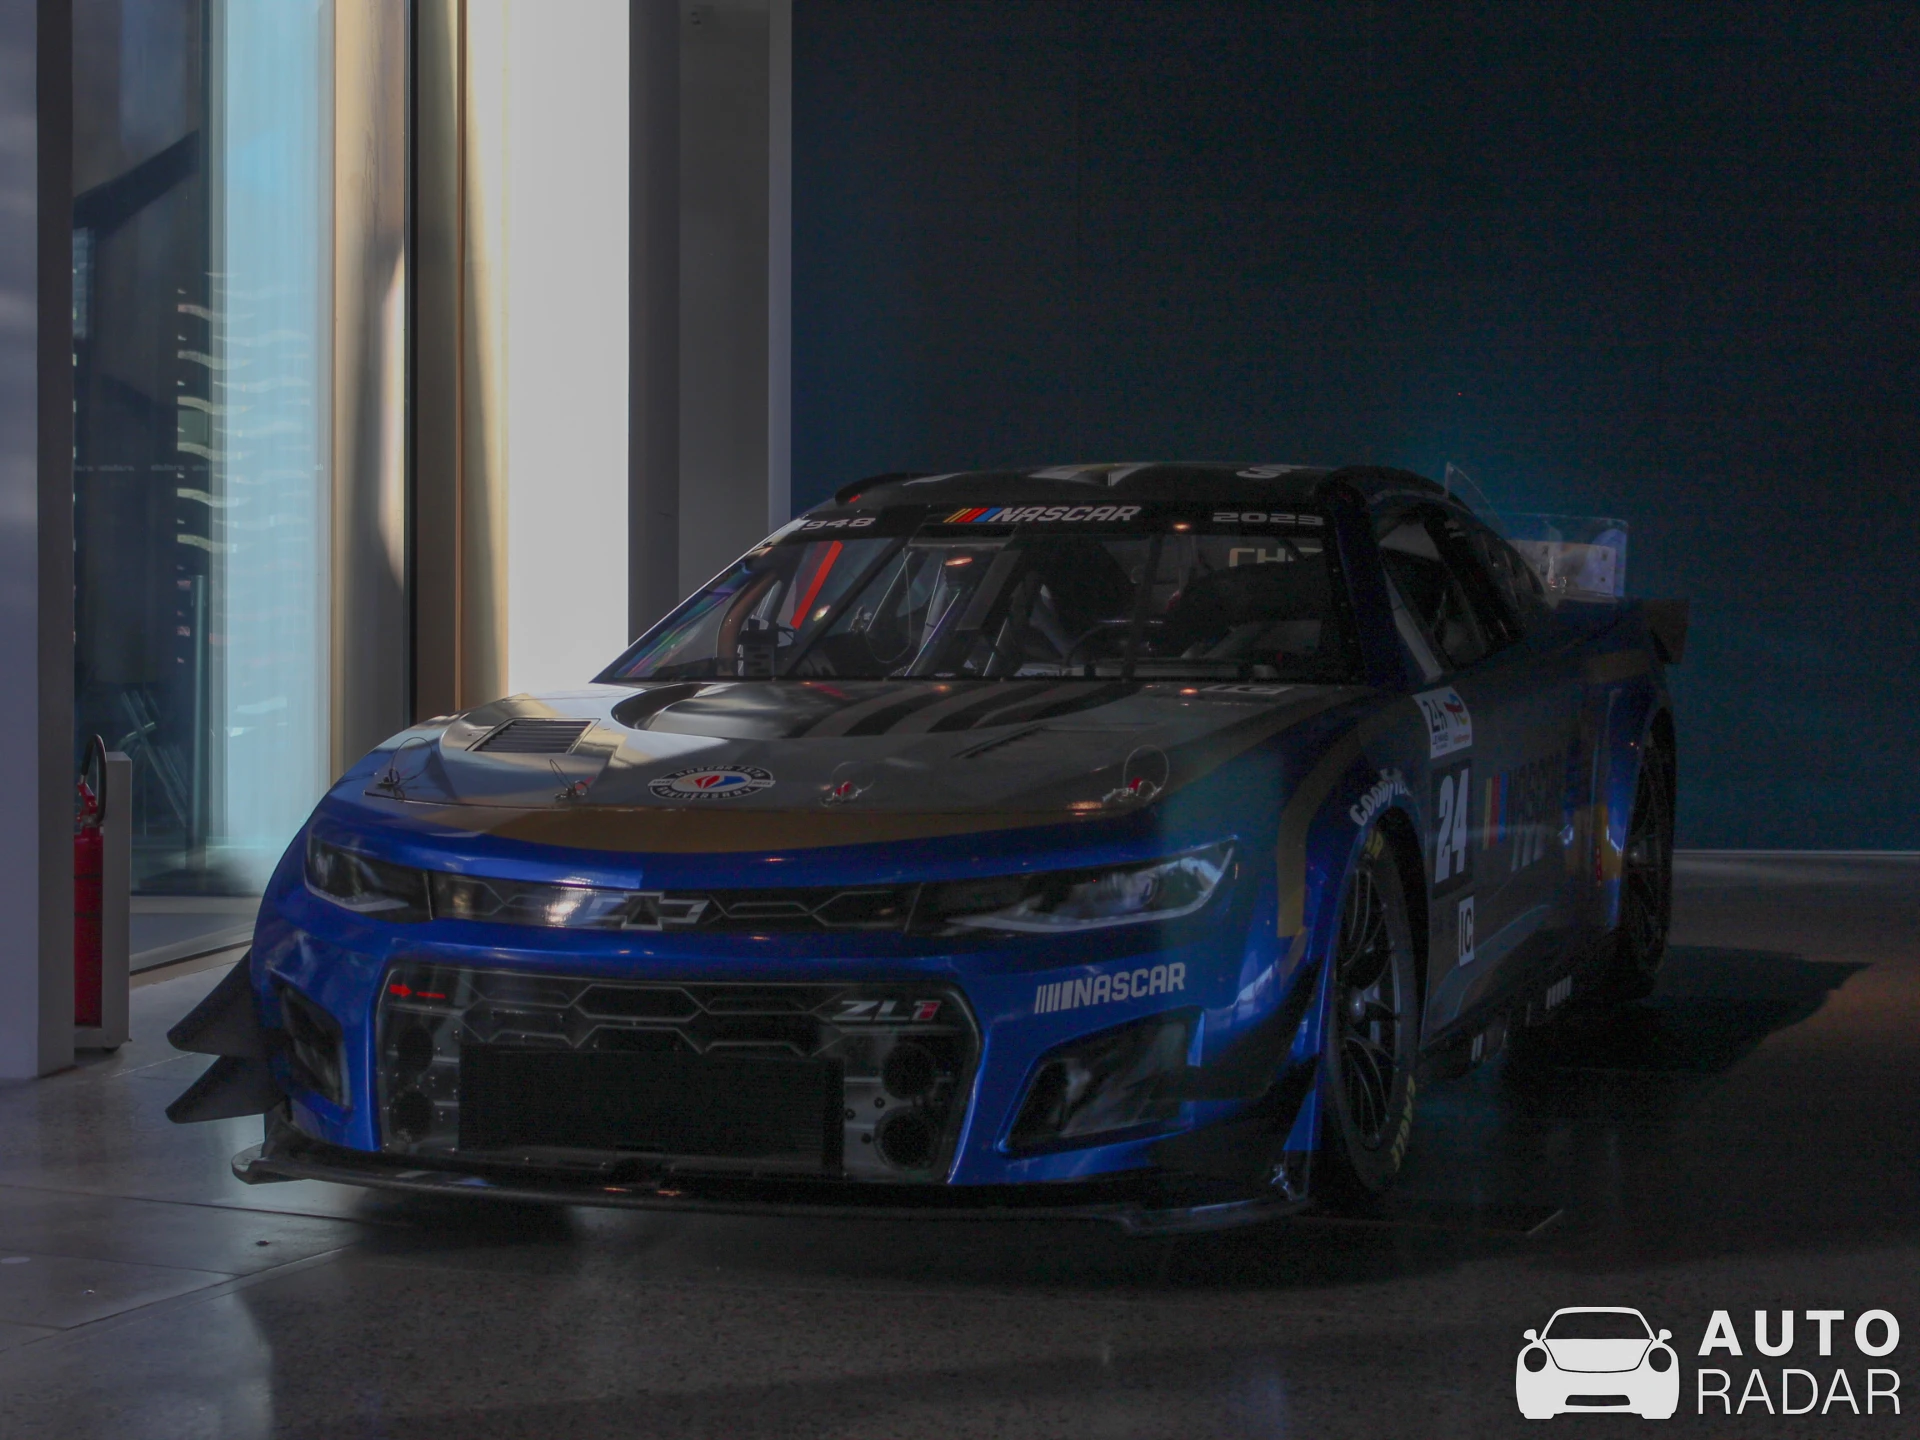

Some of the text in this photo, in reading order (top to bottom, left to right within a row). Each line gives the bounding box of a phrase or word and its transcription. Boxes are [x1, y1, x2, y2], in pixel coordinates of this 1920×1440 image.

[988, 505, 1142, 522] NASCAR
[1212, 512, 1324, 526] 2023
[1435, 768, 1469, 884] 24
[1073, 962, 1186, 1008] NASCAR
[832, 1001, 942, 1022] ZL1
